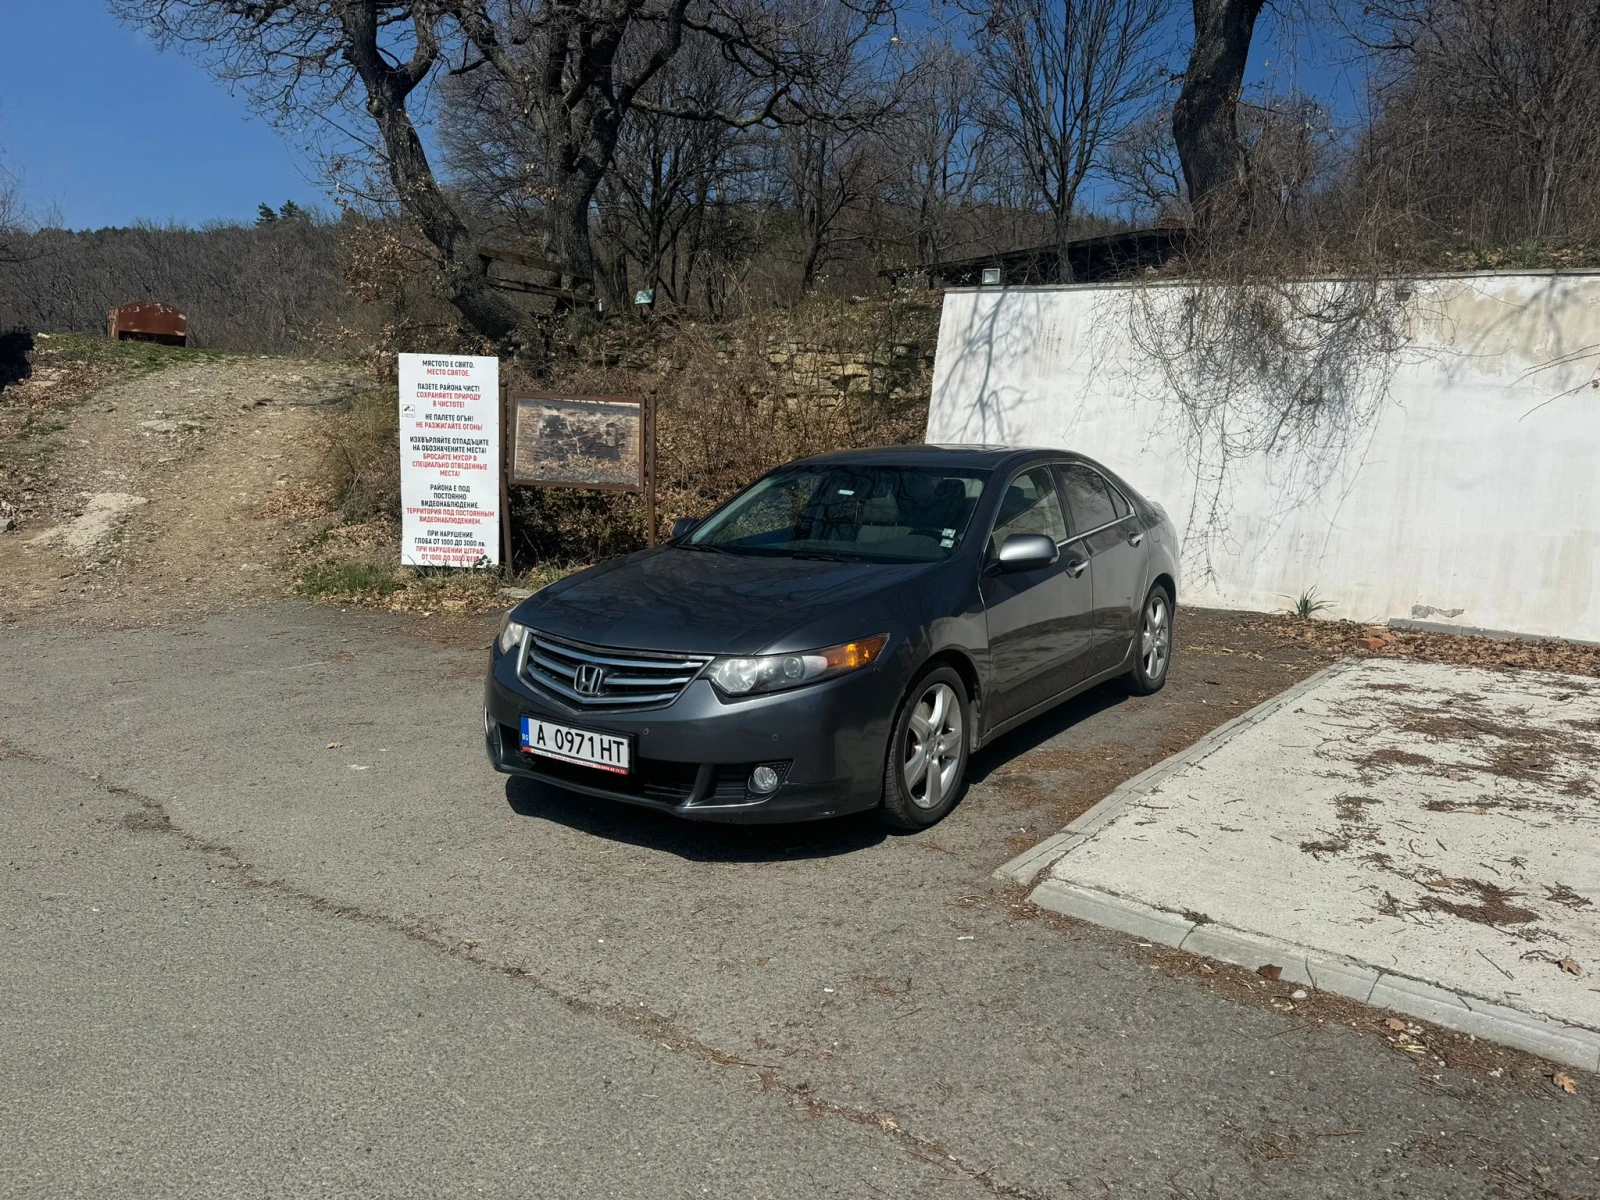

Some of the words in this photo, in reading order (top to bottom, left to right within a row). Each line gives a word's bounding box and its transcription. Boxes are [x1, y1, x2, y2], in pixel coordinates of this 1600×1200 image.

[440, 383, 462, 391] РАЙОНА
[416, 391, 452, 399] СОХРАНЯЙТЕ
[454, 393, 481, 401] ПРИРОДУ
[425, 422, 461, 430] РАЗЖИГАЙТЕ
[410, 436, 451, 444] ИЗХВЪРЛЯЙТЕ
[452, 438, 489, 446] ОТПАДЪЦИТЕ
[422, 445, 465, 453] ОБОЗНАЧЕНИТЕ
[430, 483, 452, 491] РАЙОНА
[537, 724, 546, 746] A
